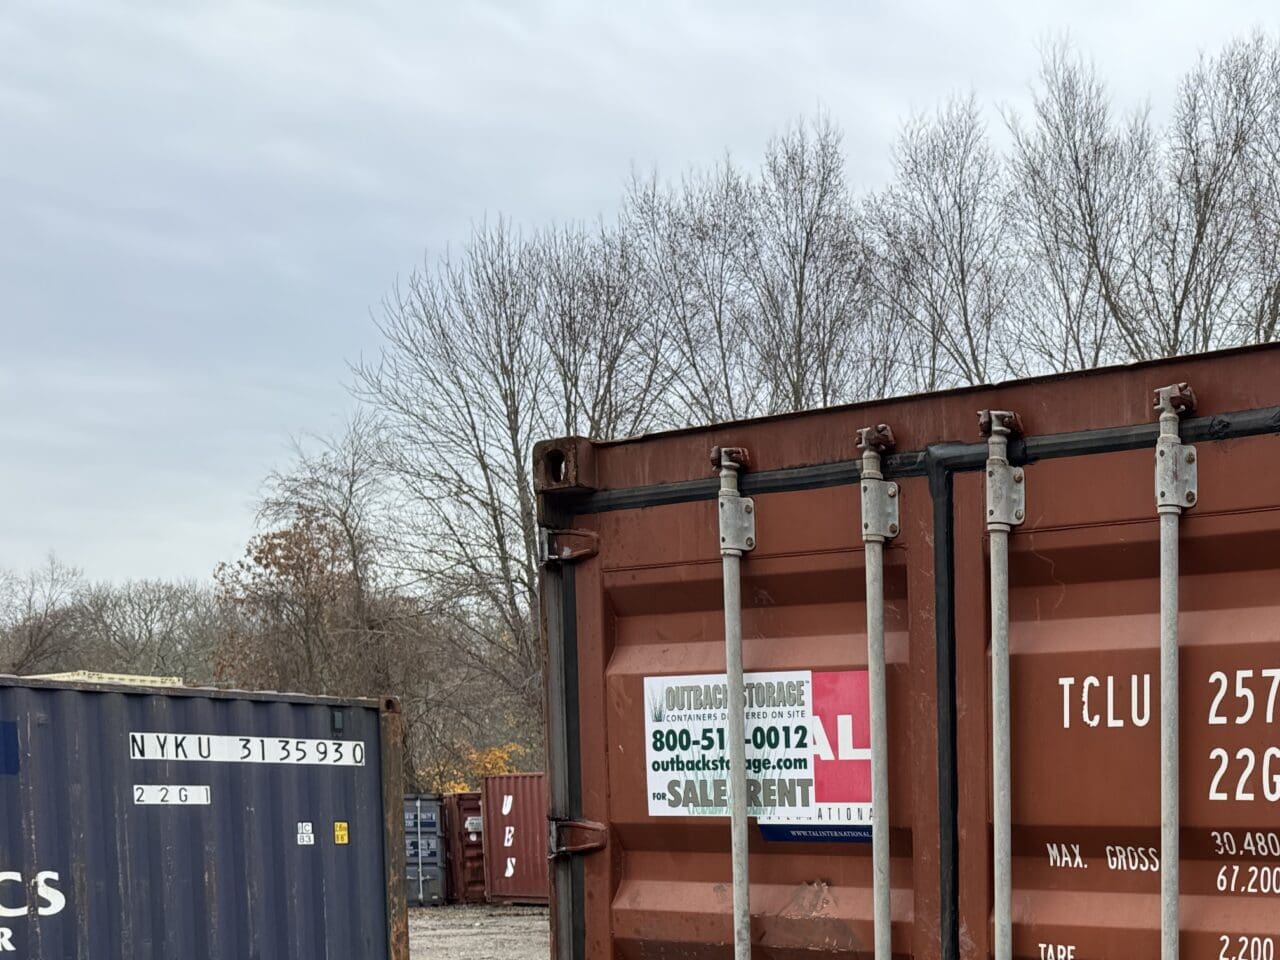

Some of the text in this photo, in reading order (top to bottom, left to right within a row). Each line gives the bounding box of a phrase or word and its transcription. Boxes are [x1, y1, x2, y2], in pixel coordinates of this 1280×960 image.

[666, 713, 718, 722] CONTAINERS
[771, 711, 784, 719] ON
[787, 710, 806, 719] SITE
[1058, 674, 1151, 729] TCLU
[130, 734, 364, 764] NYKU 3135930
[652, 725, 808, 751] 800-51-0012
[812, 714, 873, 760] AL
[652, 753, 808, 774] outbackstoge.com
[135, 787, 210, 803] 22G1
[652, 778, 813, 807] FOR SALE RENT
[1046, 843, 1088, 869] MAX.
[1105, 845, 1160, 872] GROSS
